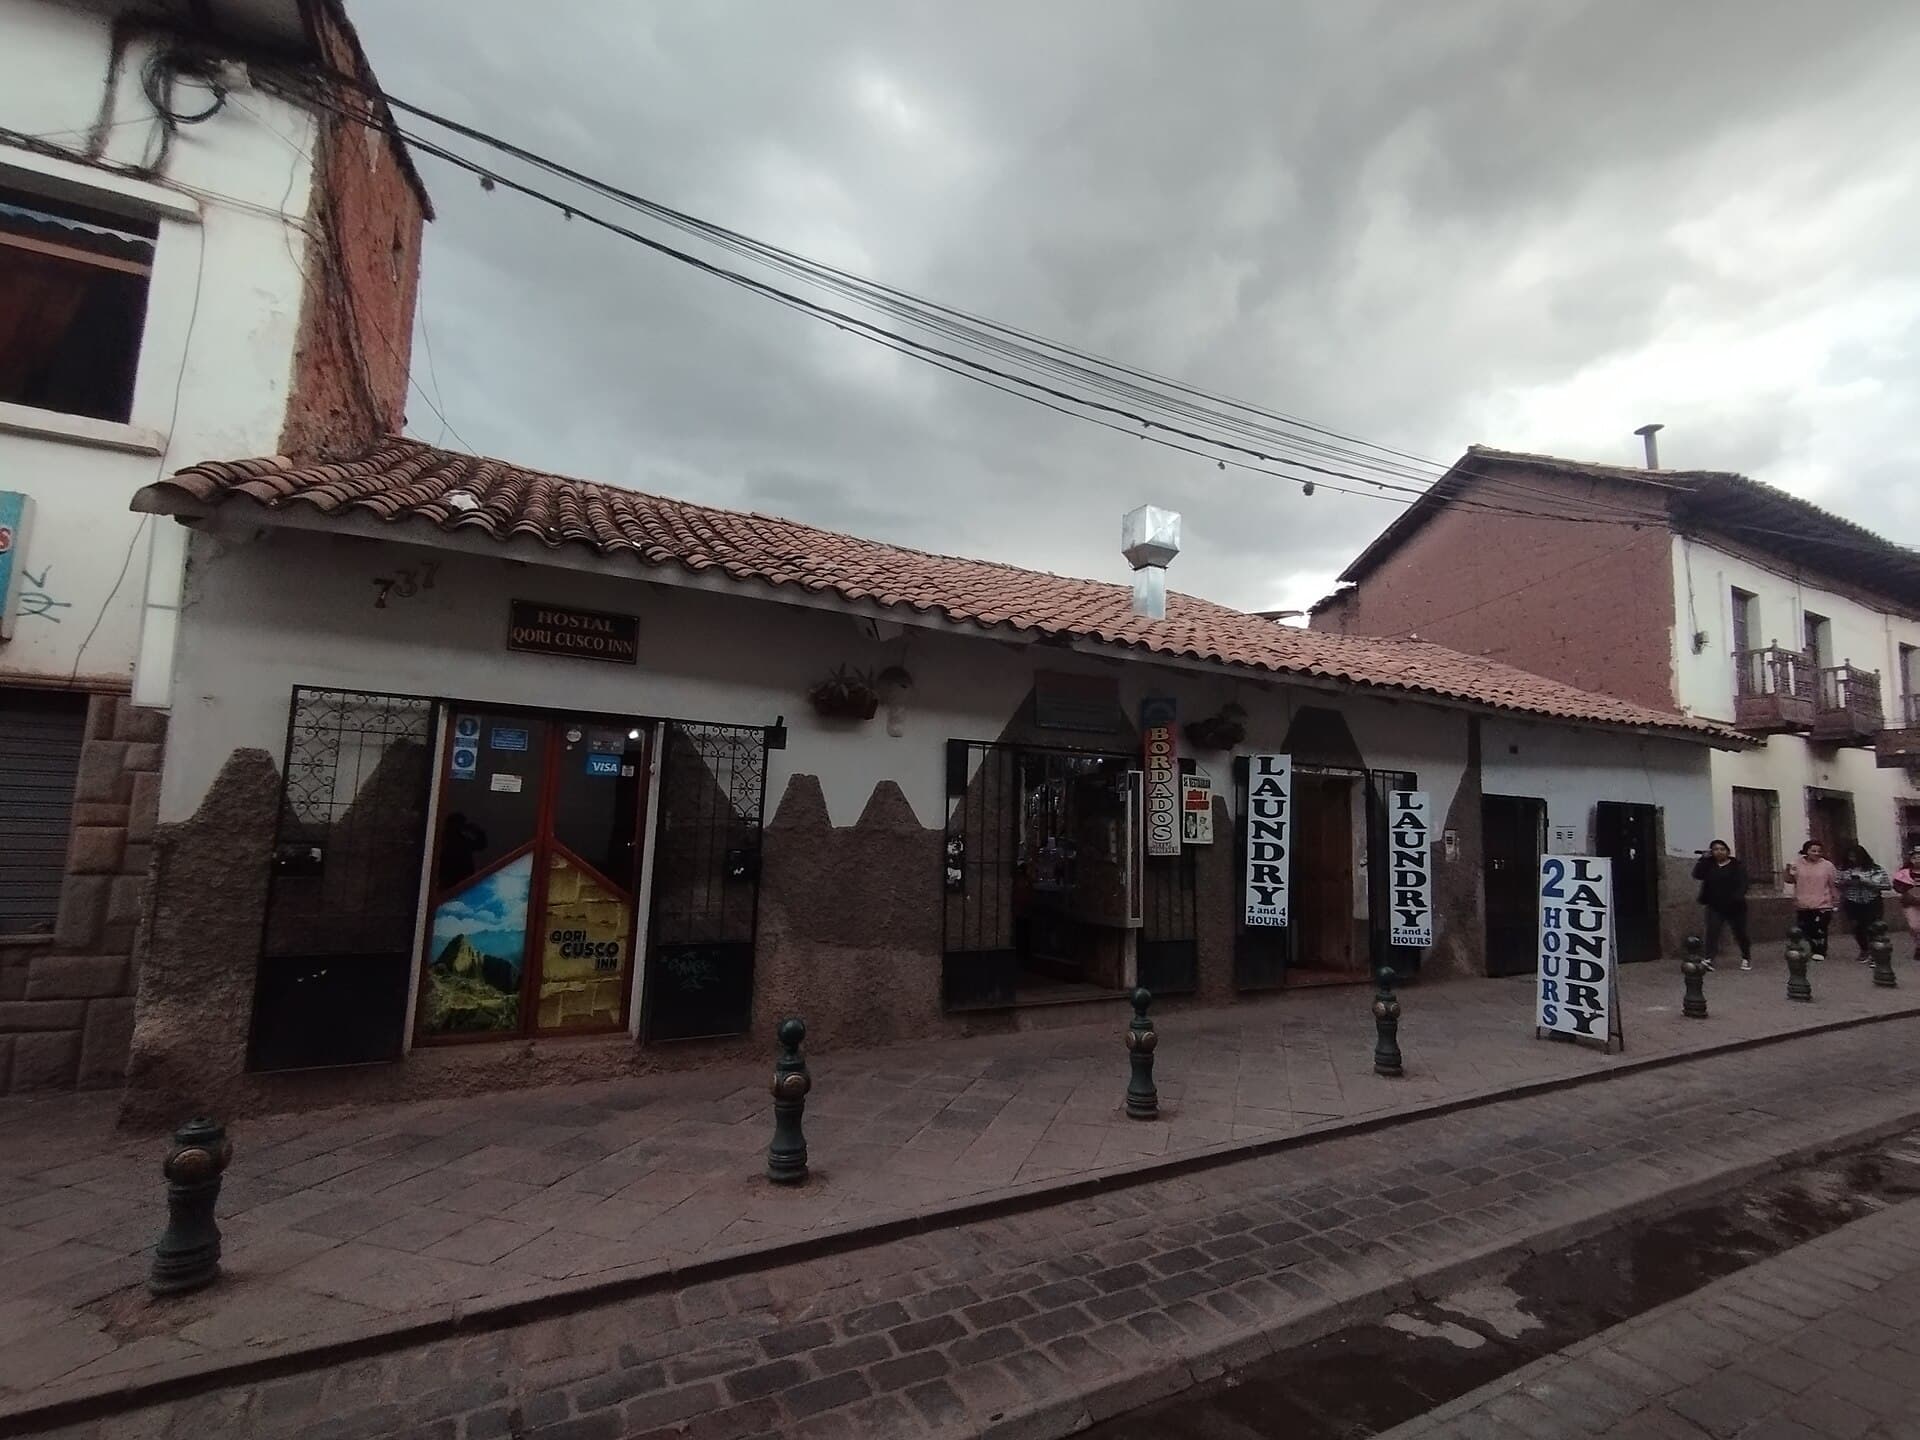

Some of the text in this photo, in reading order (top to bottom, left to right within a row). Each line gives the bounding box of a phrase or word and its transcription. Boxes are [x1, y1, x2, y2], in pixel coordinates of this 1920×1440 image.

[373, 560, 441, 609] 737
[537, 610, 615, 633] HOSTAL
[513, 627, 633, 654] QORI CUSCO INN
[591, 762, 618, 772] VISA
[1149, 727, 1174, 842] BORDADOS
[1250, 756, 1287, 906] LAUNDRY
[1392, 792, 1428, 927] LAUNDRY
[1247, 905, 1286, 917] 2 and 4
[1247, 916, 1286, 926] HOURS
[550, 930, 587, 944] QORI
[1392, 927, 1400, 935] 2
[1402, 928, 1421, 936] and
[1393, 936, 1431, 945] HOURS
[560, 942, 619, 959] CUSCO
[1541, 858, 1565, 1027] 2 HOURS
[1564, 859, 1607, 1034] LAUNDRY
[596, 958, 618, 969] INN
